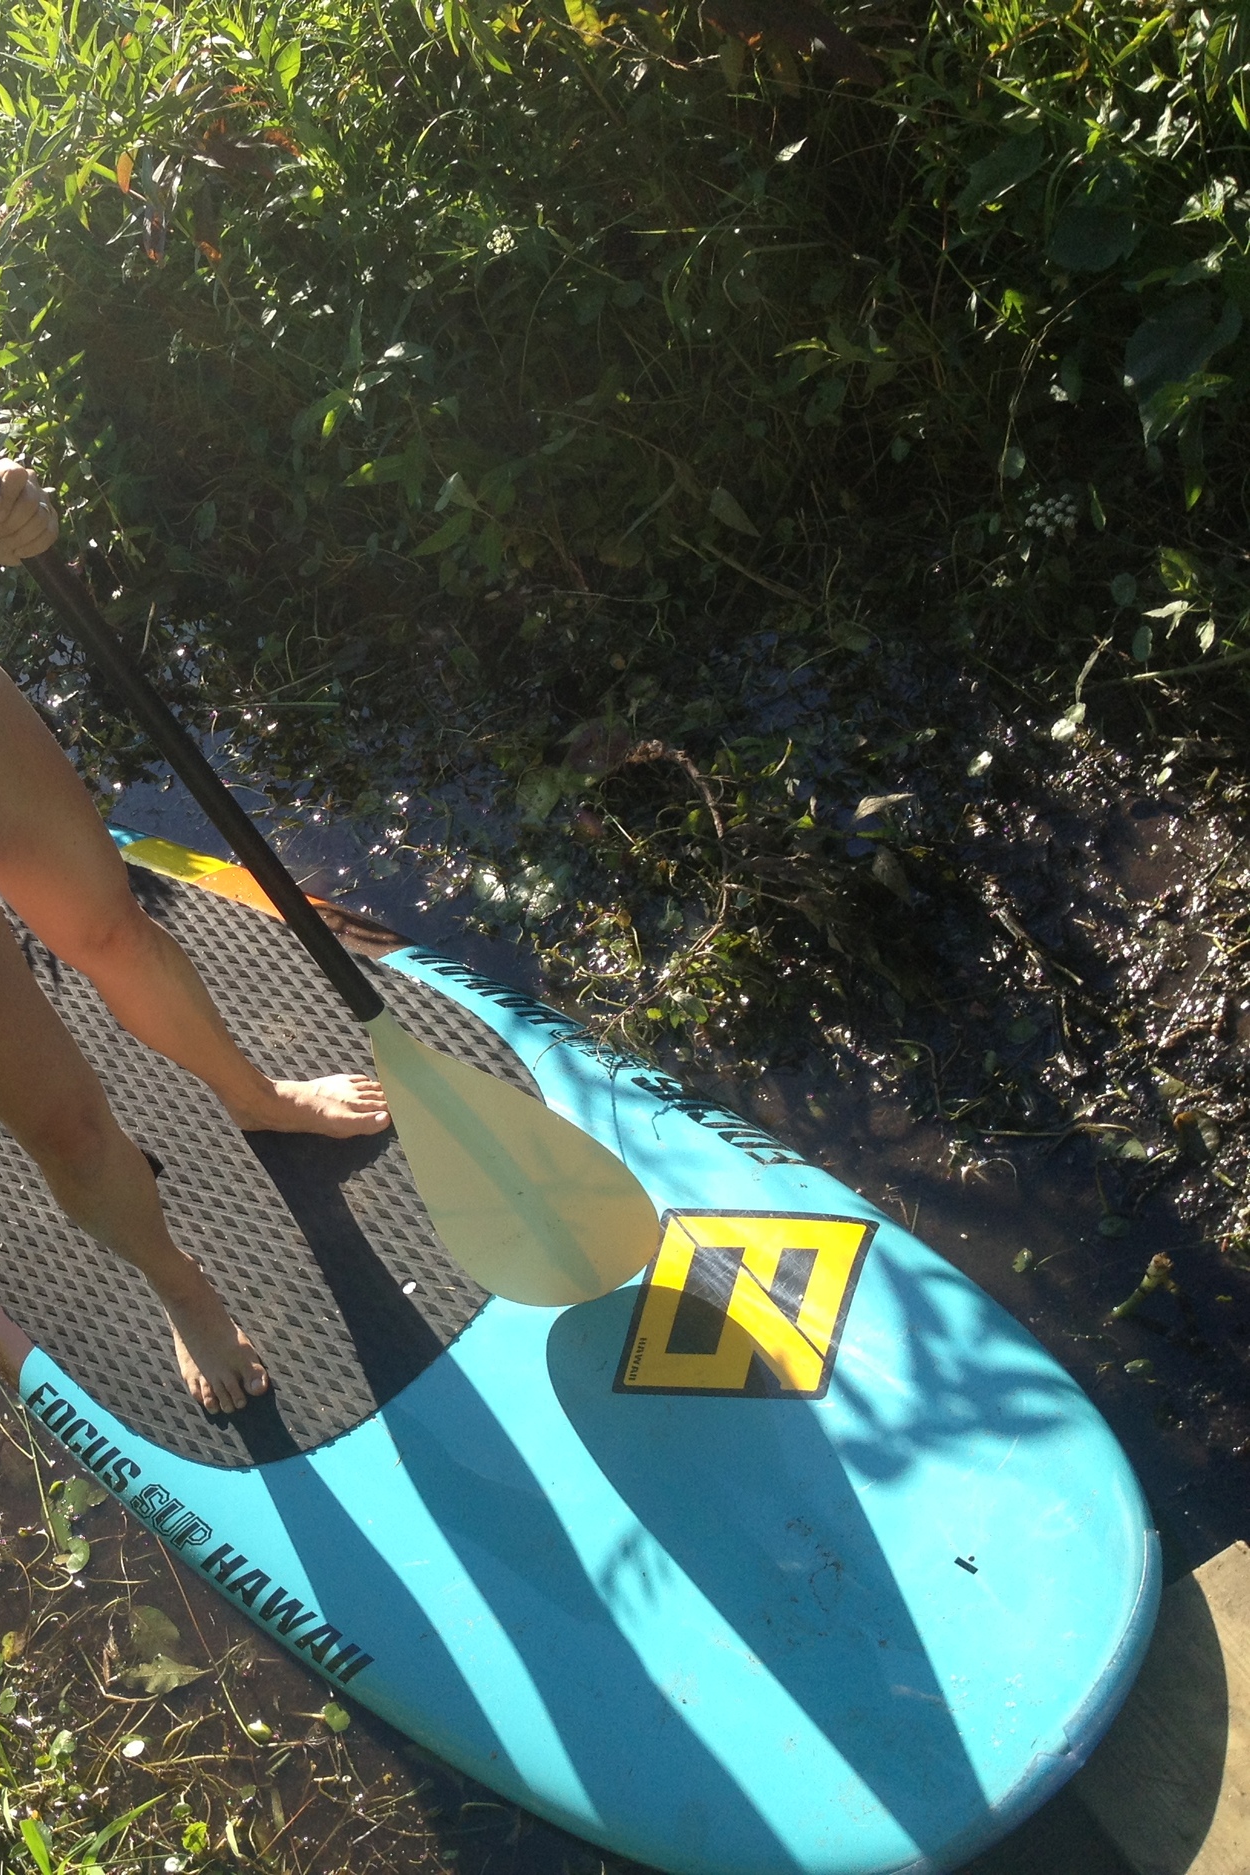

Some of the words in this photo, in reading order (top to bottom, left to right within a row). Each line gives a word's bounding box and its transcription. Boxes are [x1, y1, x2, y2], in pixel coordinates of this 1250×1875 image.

[628, 1337, 648, 1381] HAWAII
[25, 1382, 142, 1494] FOCUS
[130, 1483, 213, 1551] SUP
[200, 1542, 375, 1685] HAWAII
